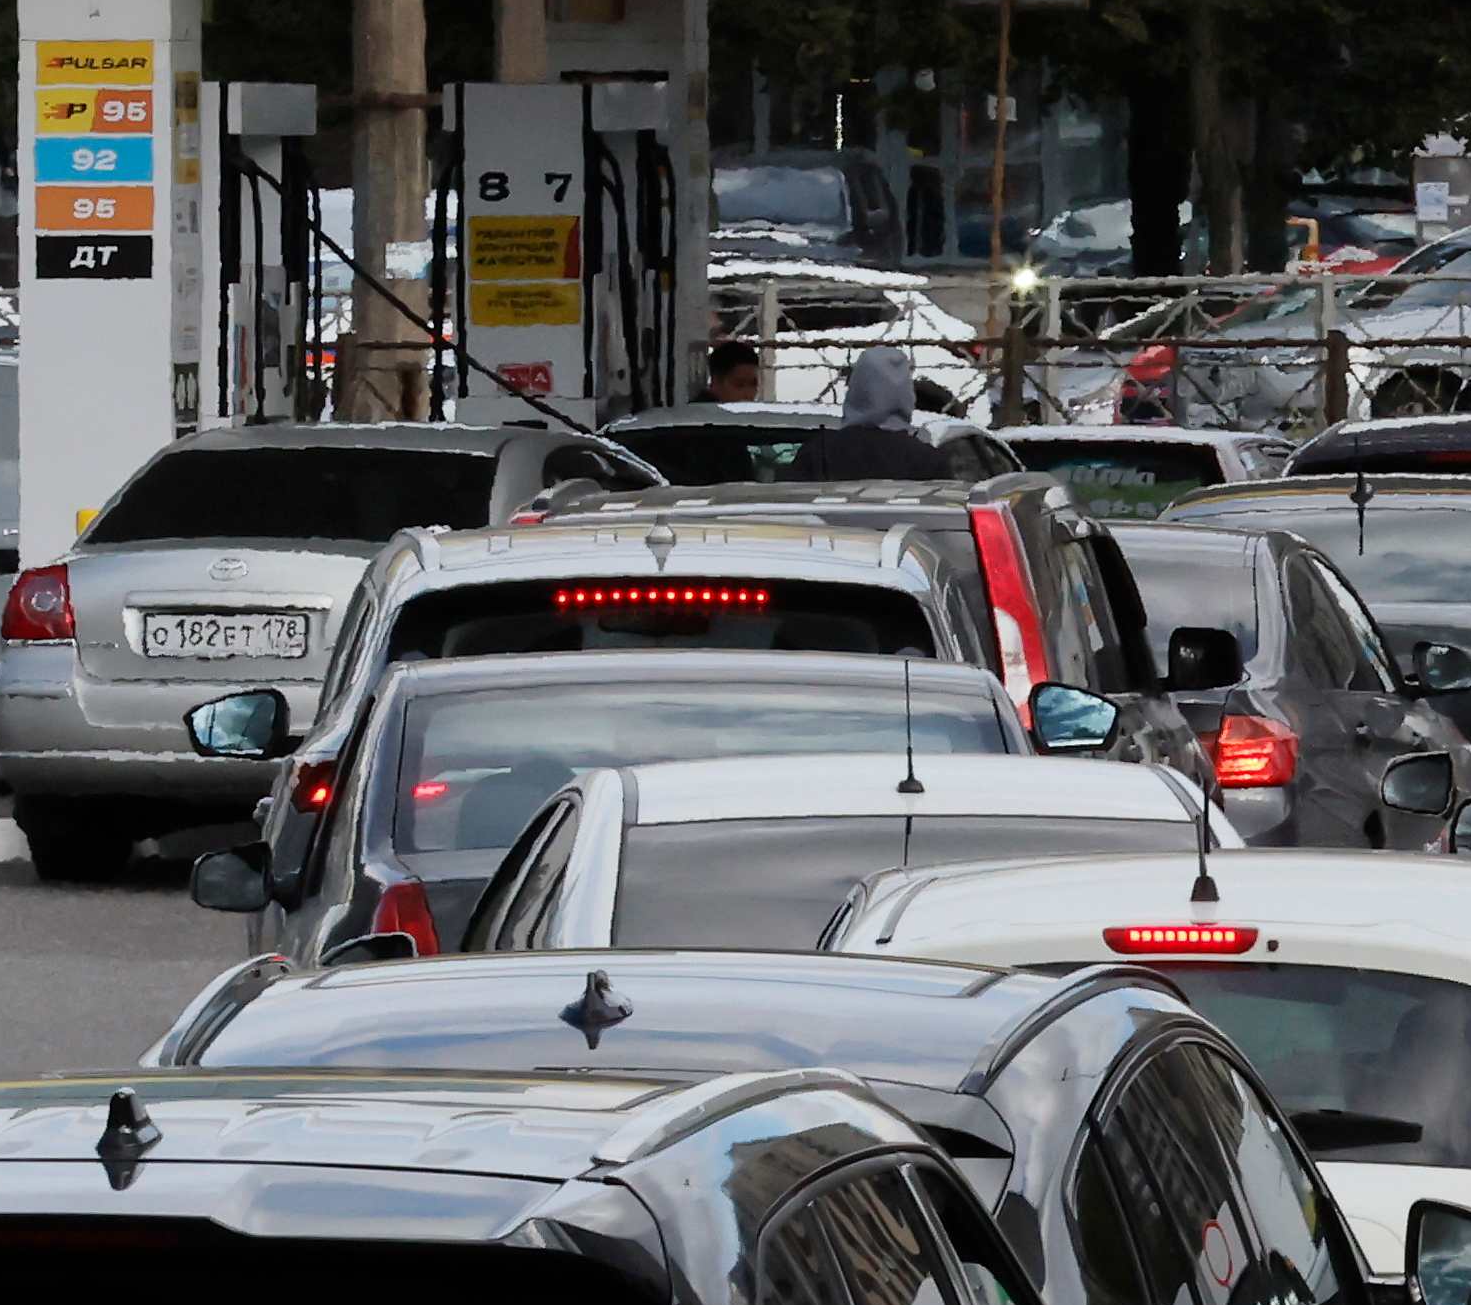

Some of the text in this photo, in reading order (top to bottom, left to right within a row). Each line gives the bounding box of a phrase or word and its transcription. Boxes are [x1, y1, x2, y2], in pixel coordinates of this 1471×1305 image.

[58, 56, 148, 71] PULSAR
[103, 100, 147, 123] 95
[71, 148, 118, 172] 92
[479, 171, 573, 203] 8 7
[73, 198, 117, 220] 95
[69, 245, 119, 270] ДТ
[152, 618, 299, 648] О182ЕТ 178
